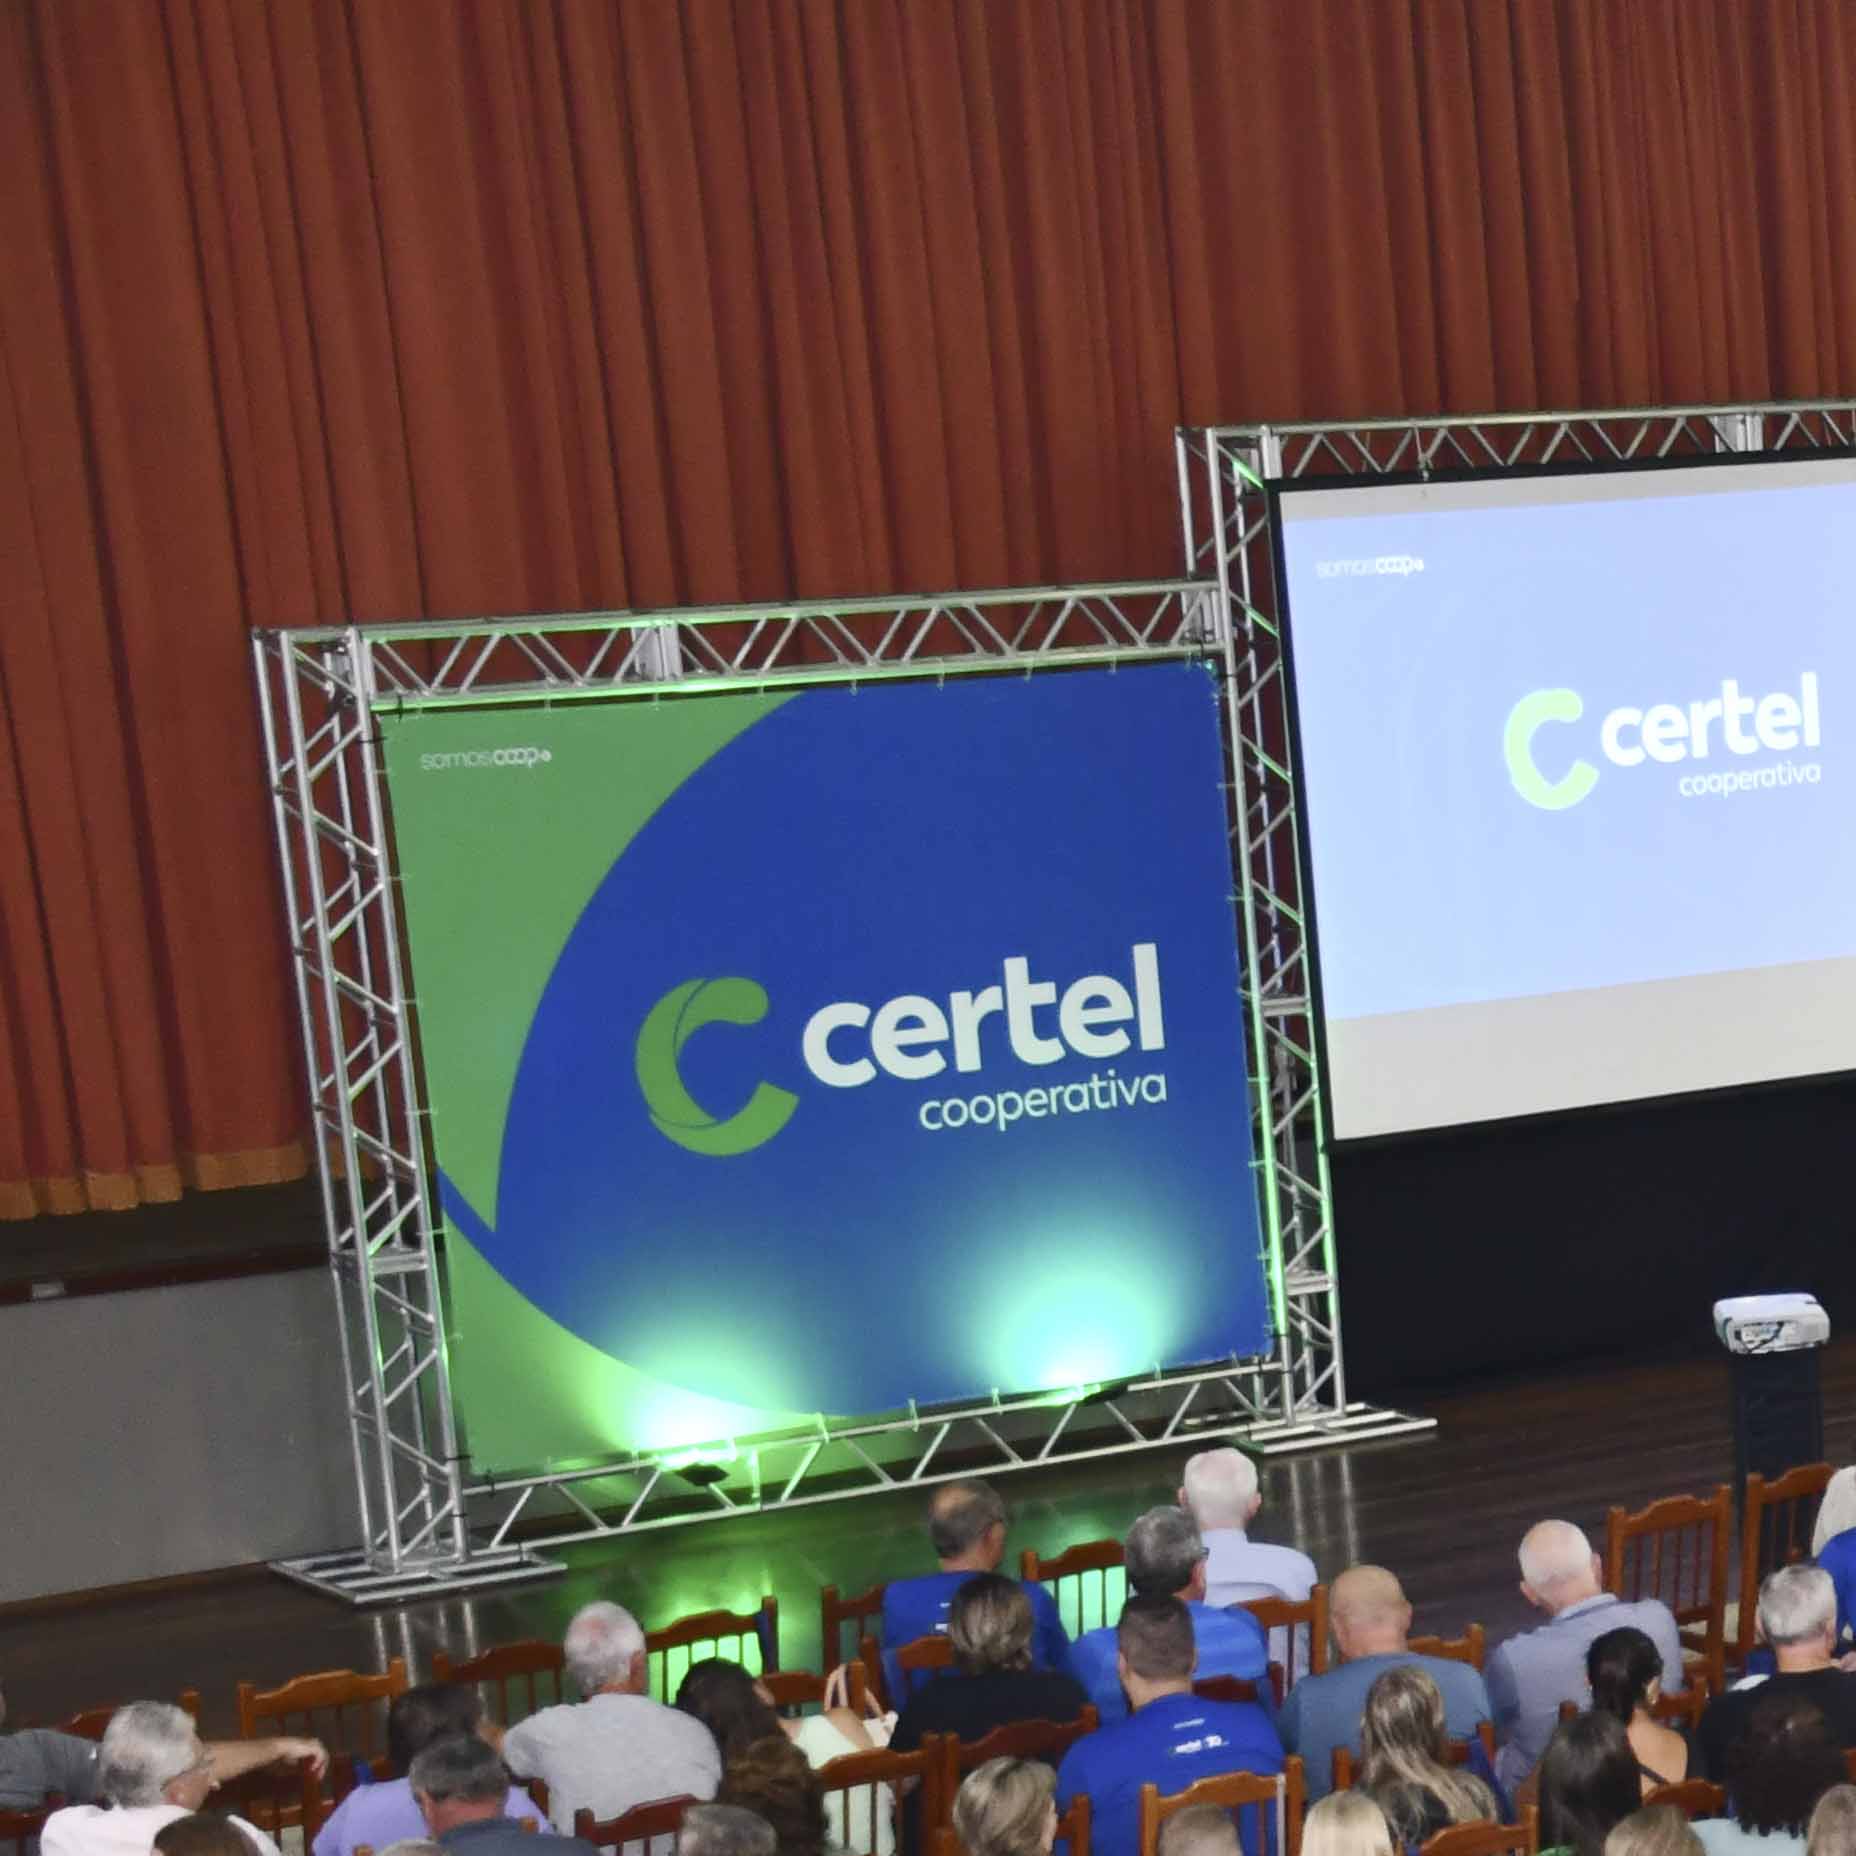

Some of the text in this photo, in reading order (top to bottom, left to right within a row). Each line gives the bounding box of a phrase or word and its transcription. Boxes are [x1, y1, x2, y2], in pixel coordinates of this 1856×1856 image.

[1600, 672, 1821, 767] certel
[1679, 762, 1821, 799] cooperativa
[803, 943, 1166, 1087] certel
[919, 1068, 1168, 1132] cooperativa
